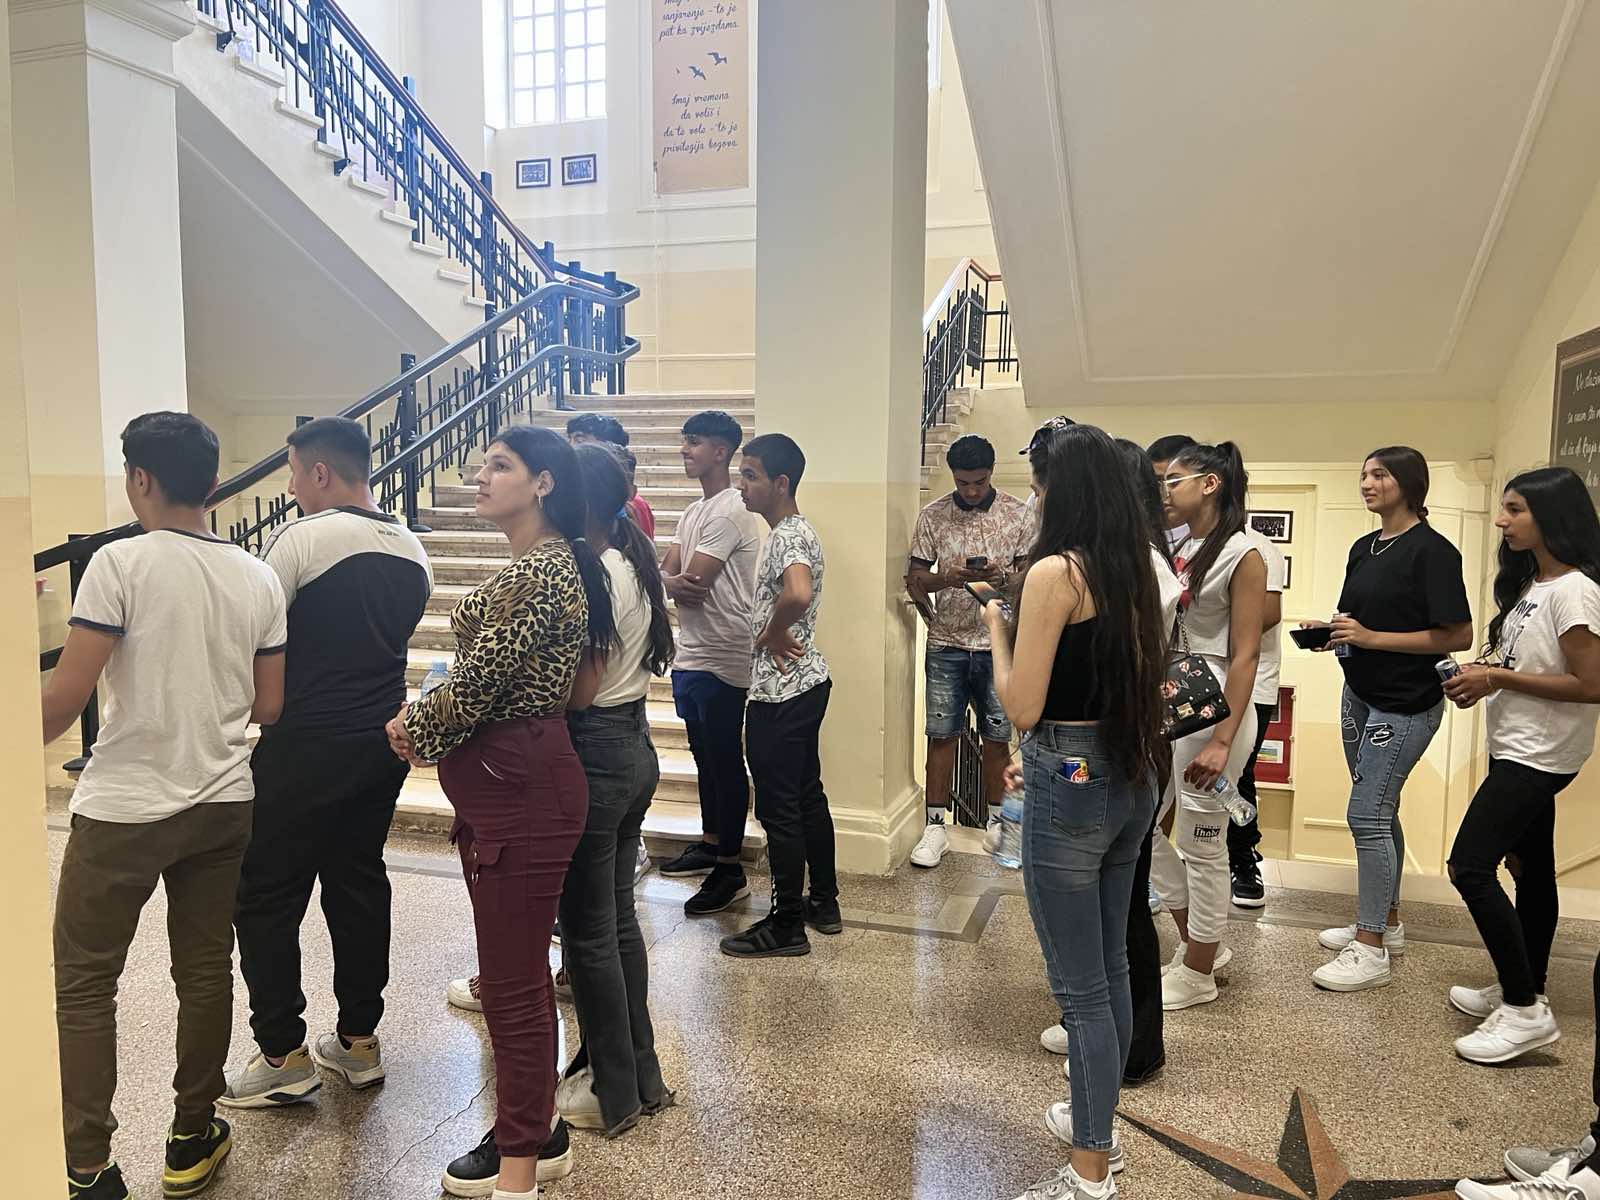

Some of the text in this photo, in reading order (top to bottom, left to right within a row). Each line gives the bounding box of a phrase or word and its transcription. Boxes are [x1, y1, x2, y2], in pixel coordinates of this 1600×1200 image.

[694, 92, 729, 103] vremena
[662, 138, 739, 158] privilegija bogova
